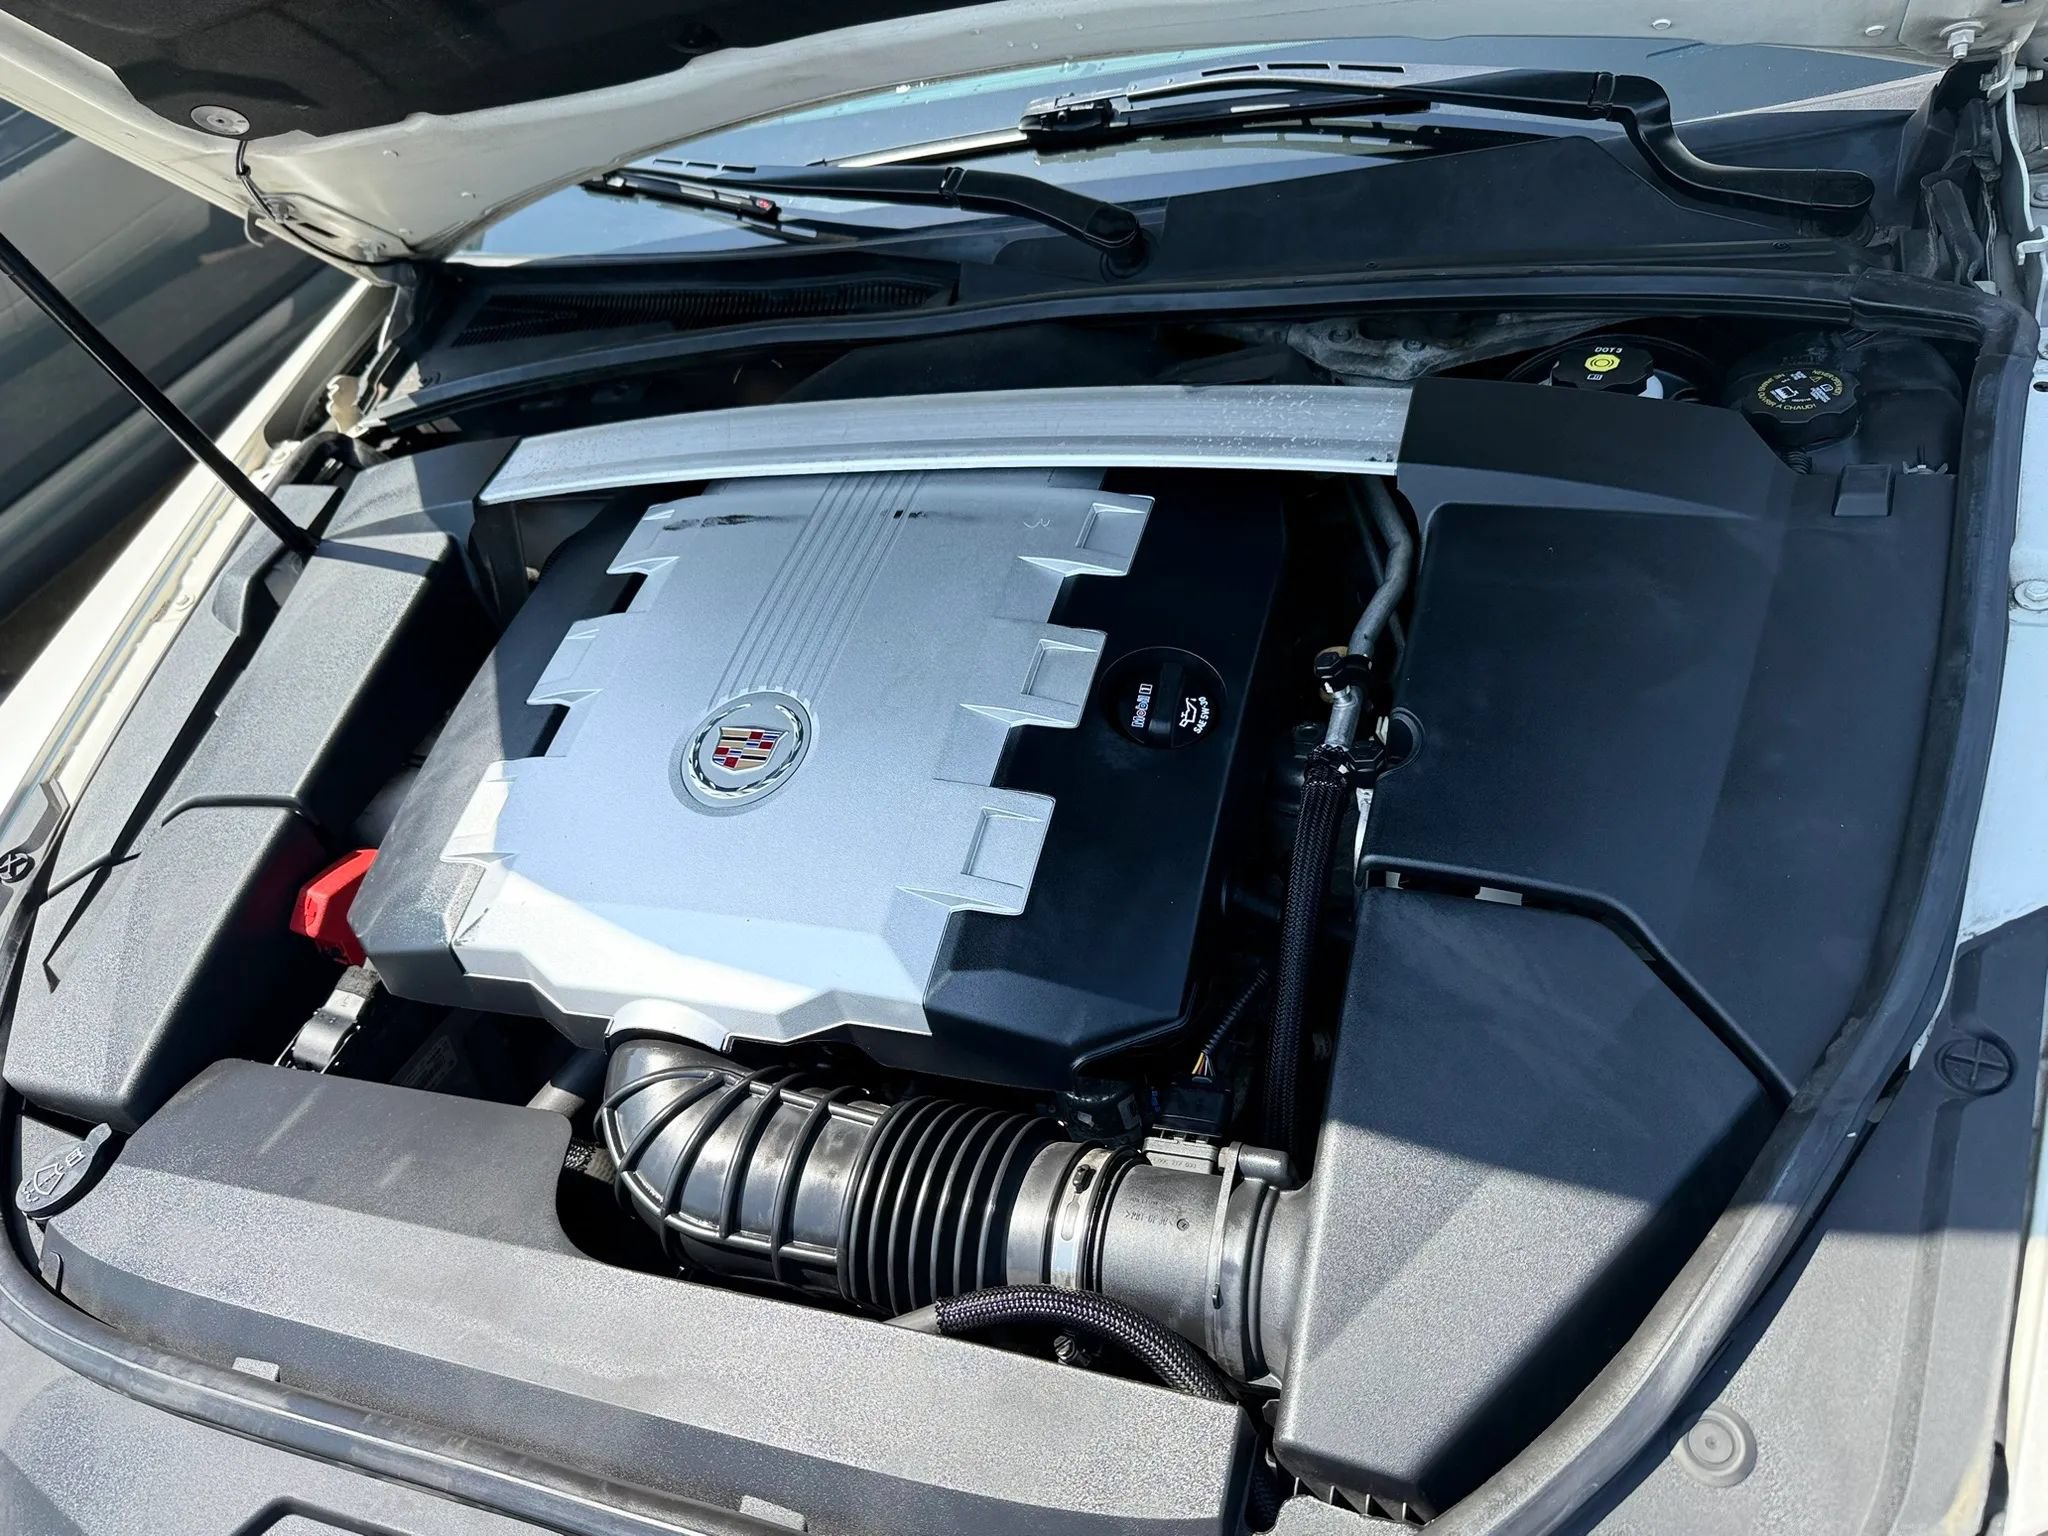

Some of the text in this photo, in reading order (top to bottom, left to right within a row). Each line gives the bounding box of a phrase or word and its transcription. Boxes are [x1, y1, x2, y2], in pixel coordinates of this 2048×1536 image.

[1131, 695, 1151, 728] Mobil
[1193, 696, 1210, 734] SAE 5W-30
